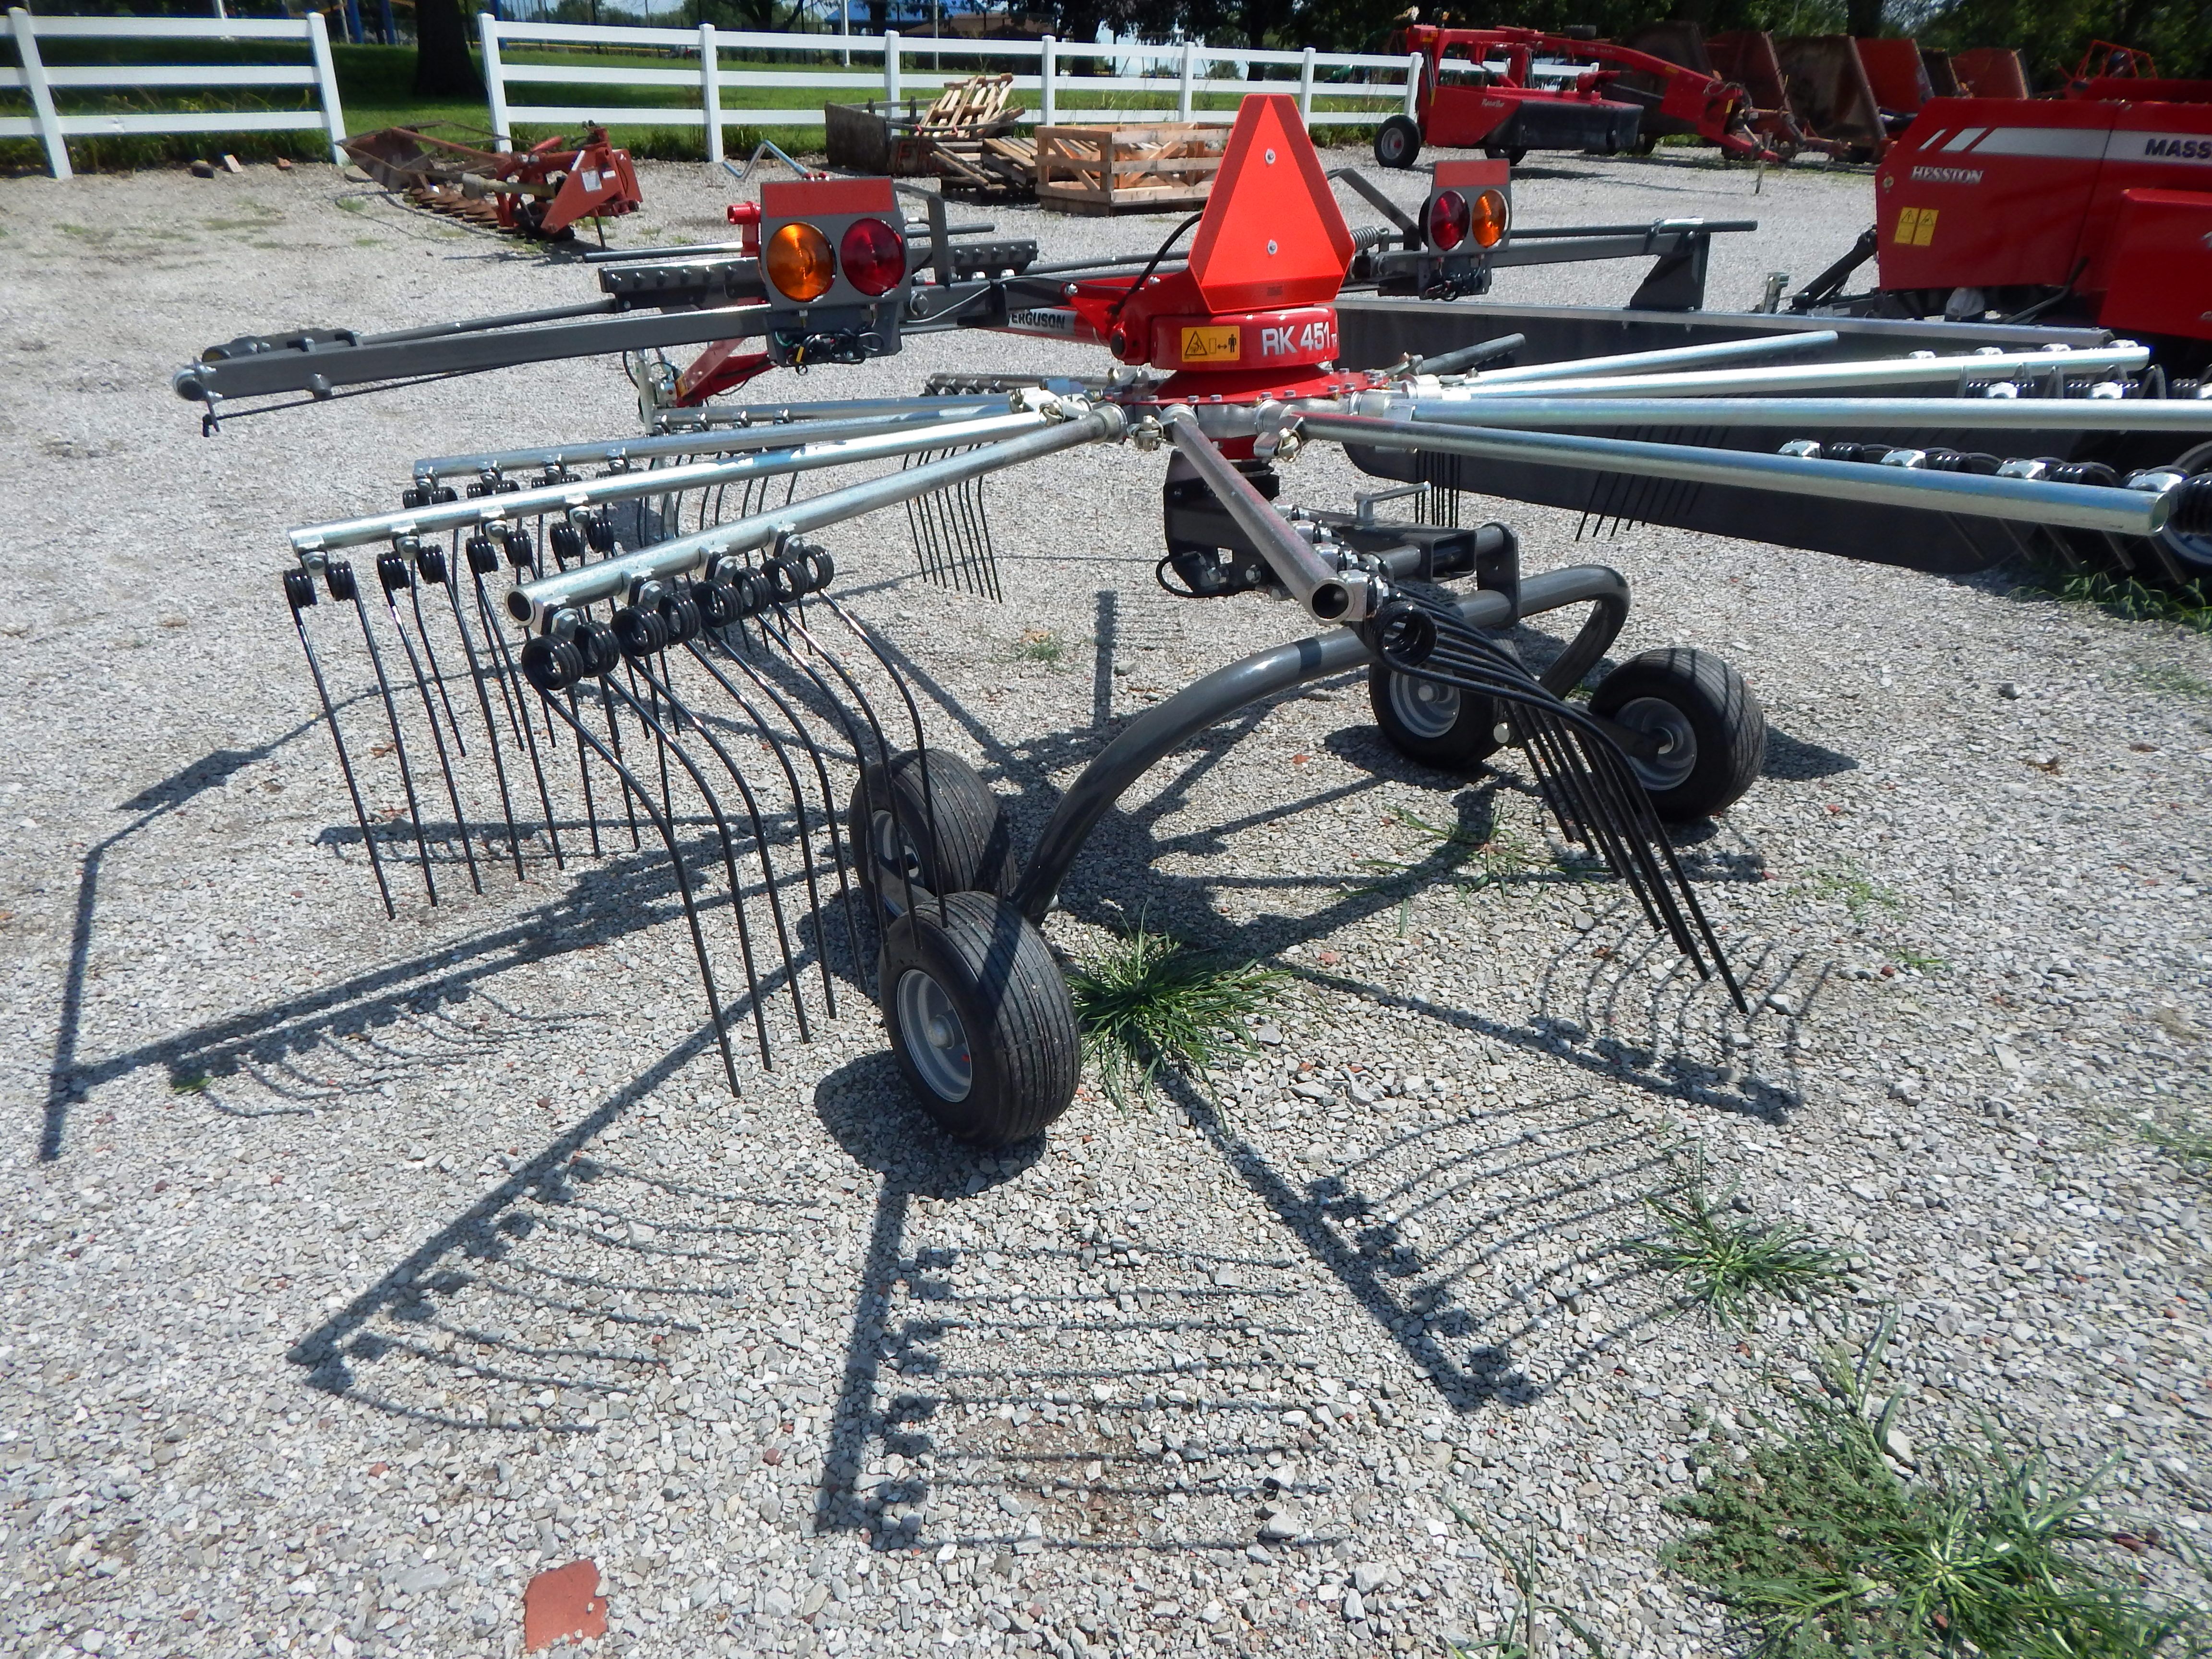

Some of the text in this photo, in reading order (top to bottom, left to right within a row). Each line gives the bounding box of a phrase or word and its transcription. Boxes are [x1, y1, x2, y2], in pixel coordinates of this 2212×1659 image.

[1910, 165, 1984, 183] HESSTON
[1008, 312, 1065, 329] ERGUSON
[1262, 325, 1298, 356] RK
[1300, 321, 1330, 351] 451
